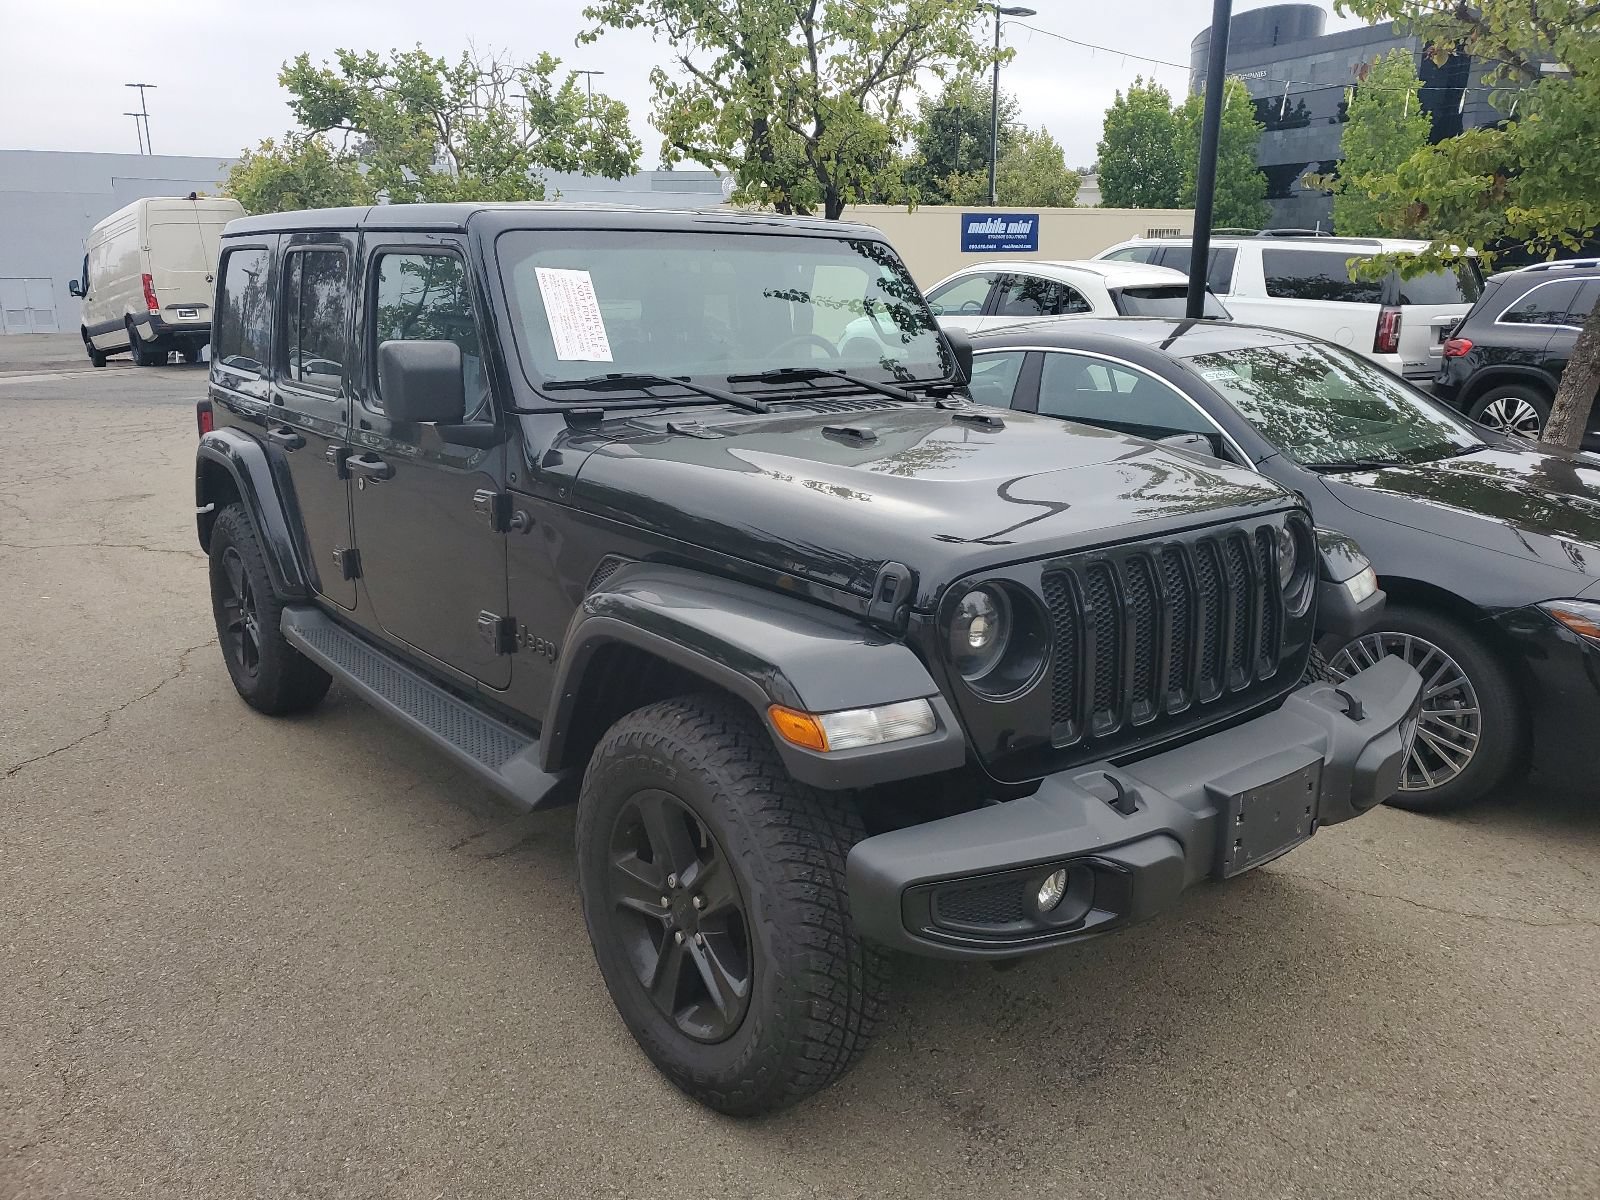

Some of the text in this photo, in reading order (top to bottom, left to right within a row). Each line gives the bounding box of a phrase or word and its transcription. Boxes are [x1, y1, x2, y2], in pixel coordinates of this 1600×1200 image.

[967, 218, 1033, 234] mobile mini
[576, 284, 599, 348] NOT FOR SALE
[582, 280, 594, 300] THIS
[589, 302, 605, 341] VEHICLE
[515, 624, 557, 665] Jeep
